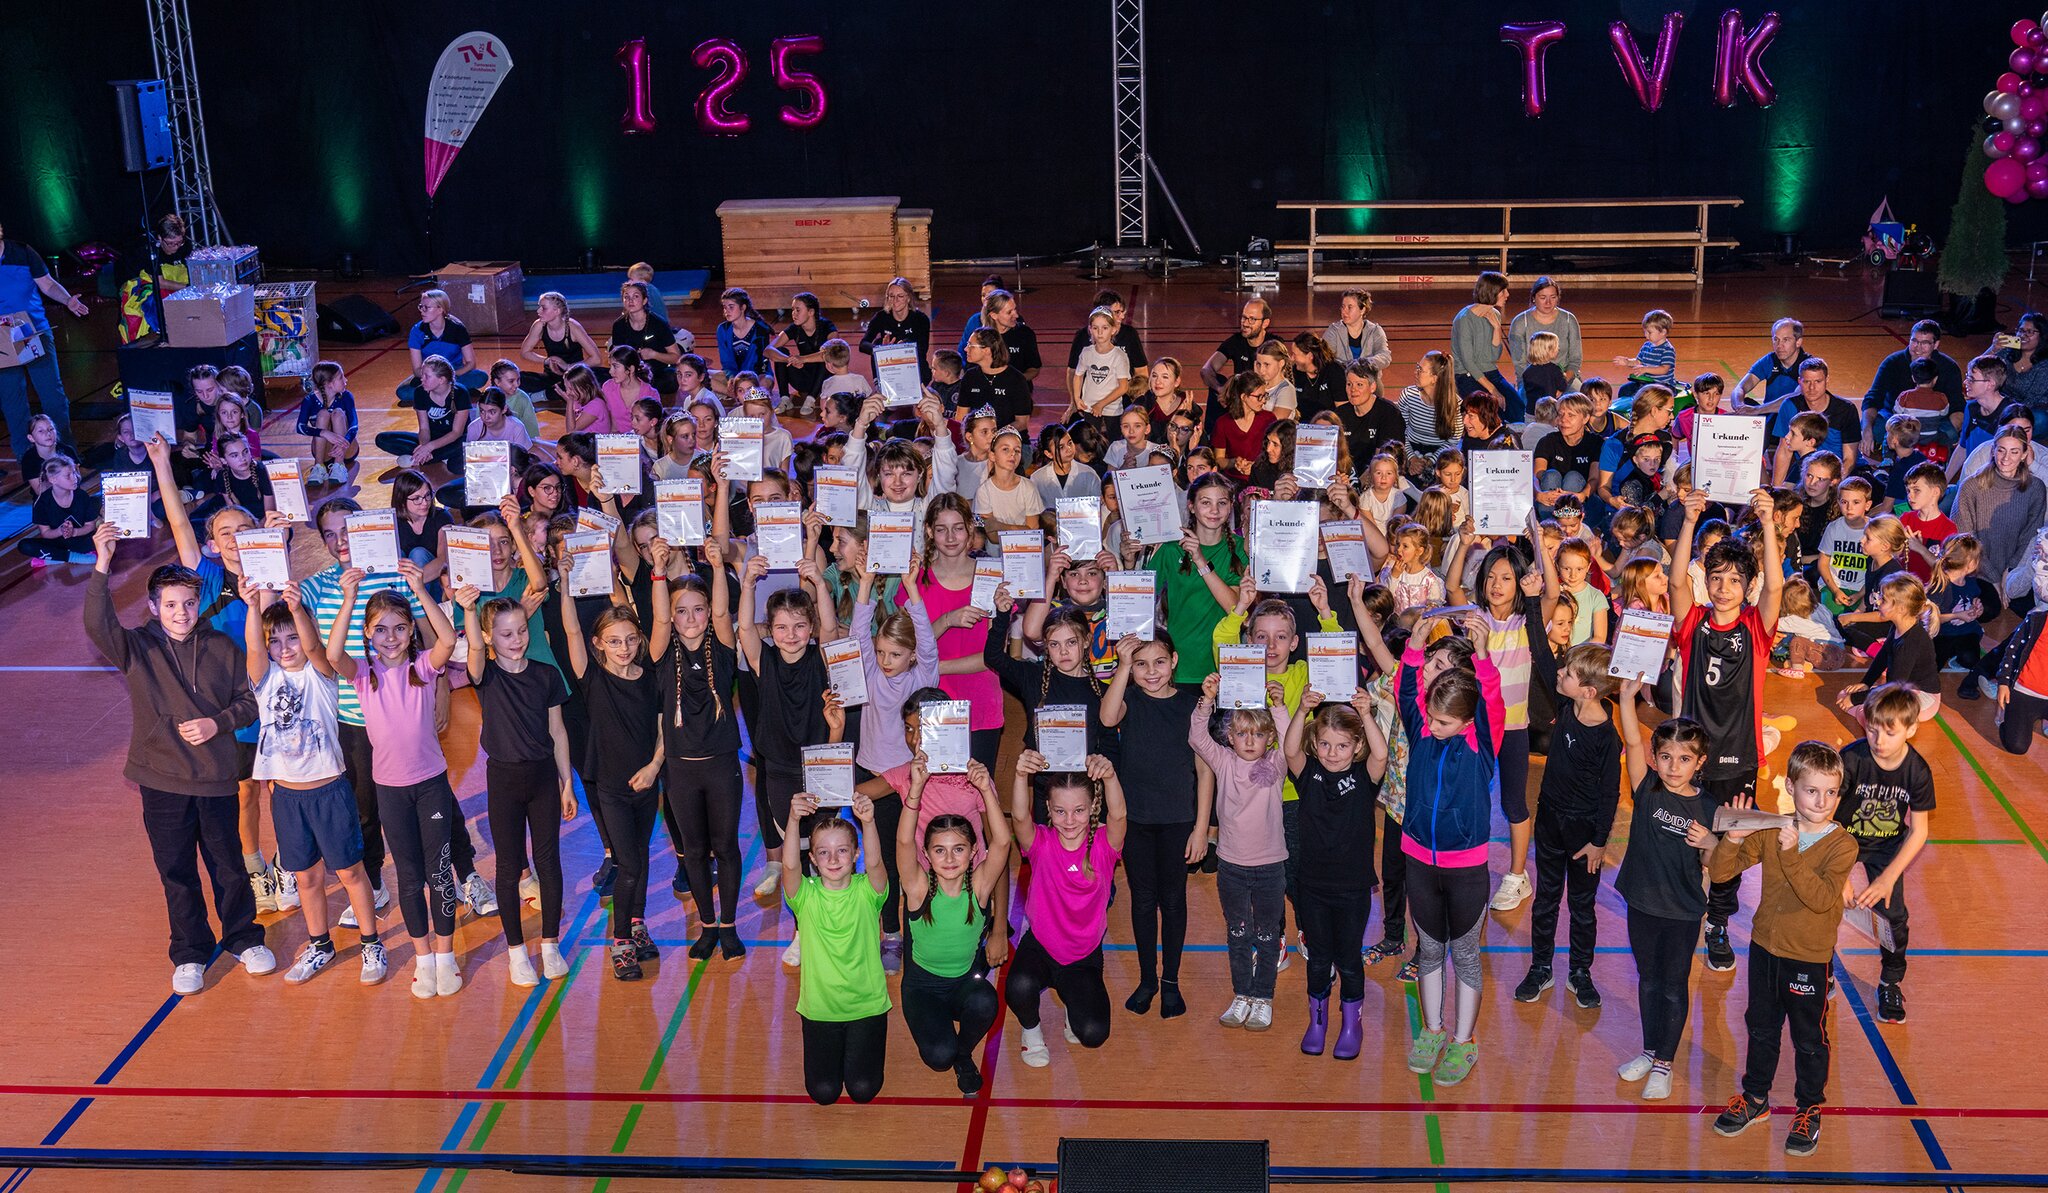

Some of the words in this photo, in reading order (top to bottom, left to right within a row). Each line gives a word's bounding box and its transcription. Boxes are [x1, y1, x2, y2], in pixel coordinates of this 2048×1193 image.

[1500, 9, 1781, 118] TVK
[795, 219, 831, 227] BENZ
[994, 388, 1006, 396] TVK
[1712, 432, 1750, 441] Urkunde
[1576, 456, 1589, 464] TVK
[1130, 481, 1162, 490] Urkunde
[1269, 519, 1306, 527] Urkunde
[1837, 569, 1859, 582] GO!
[1705, 656, 1722, 686] 5
[432, 842, 456, 918] adidas
[1789, 982, 1815, 991] NASA
